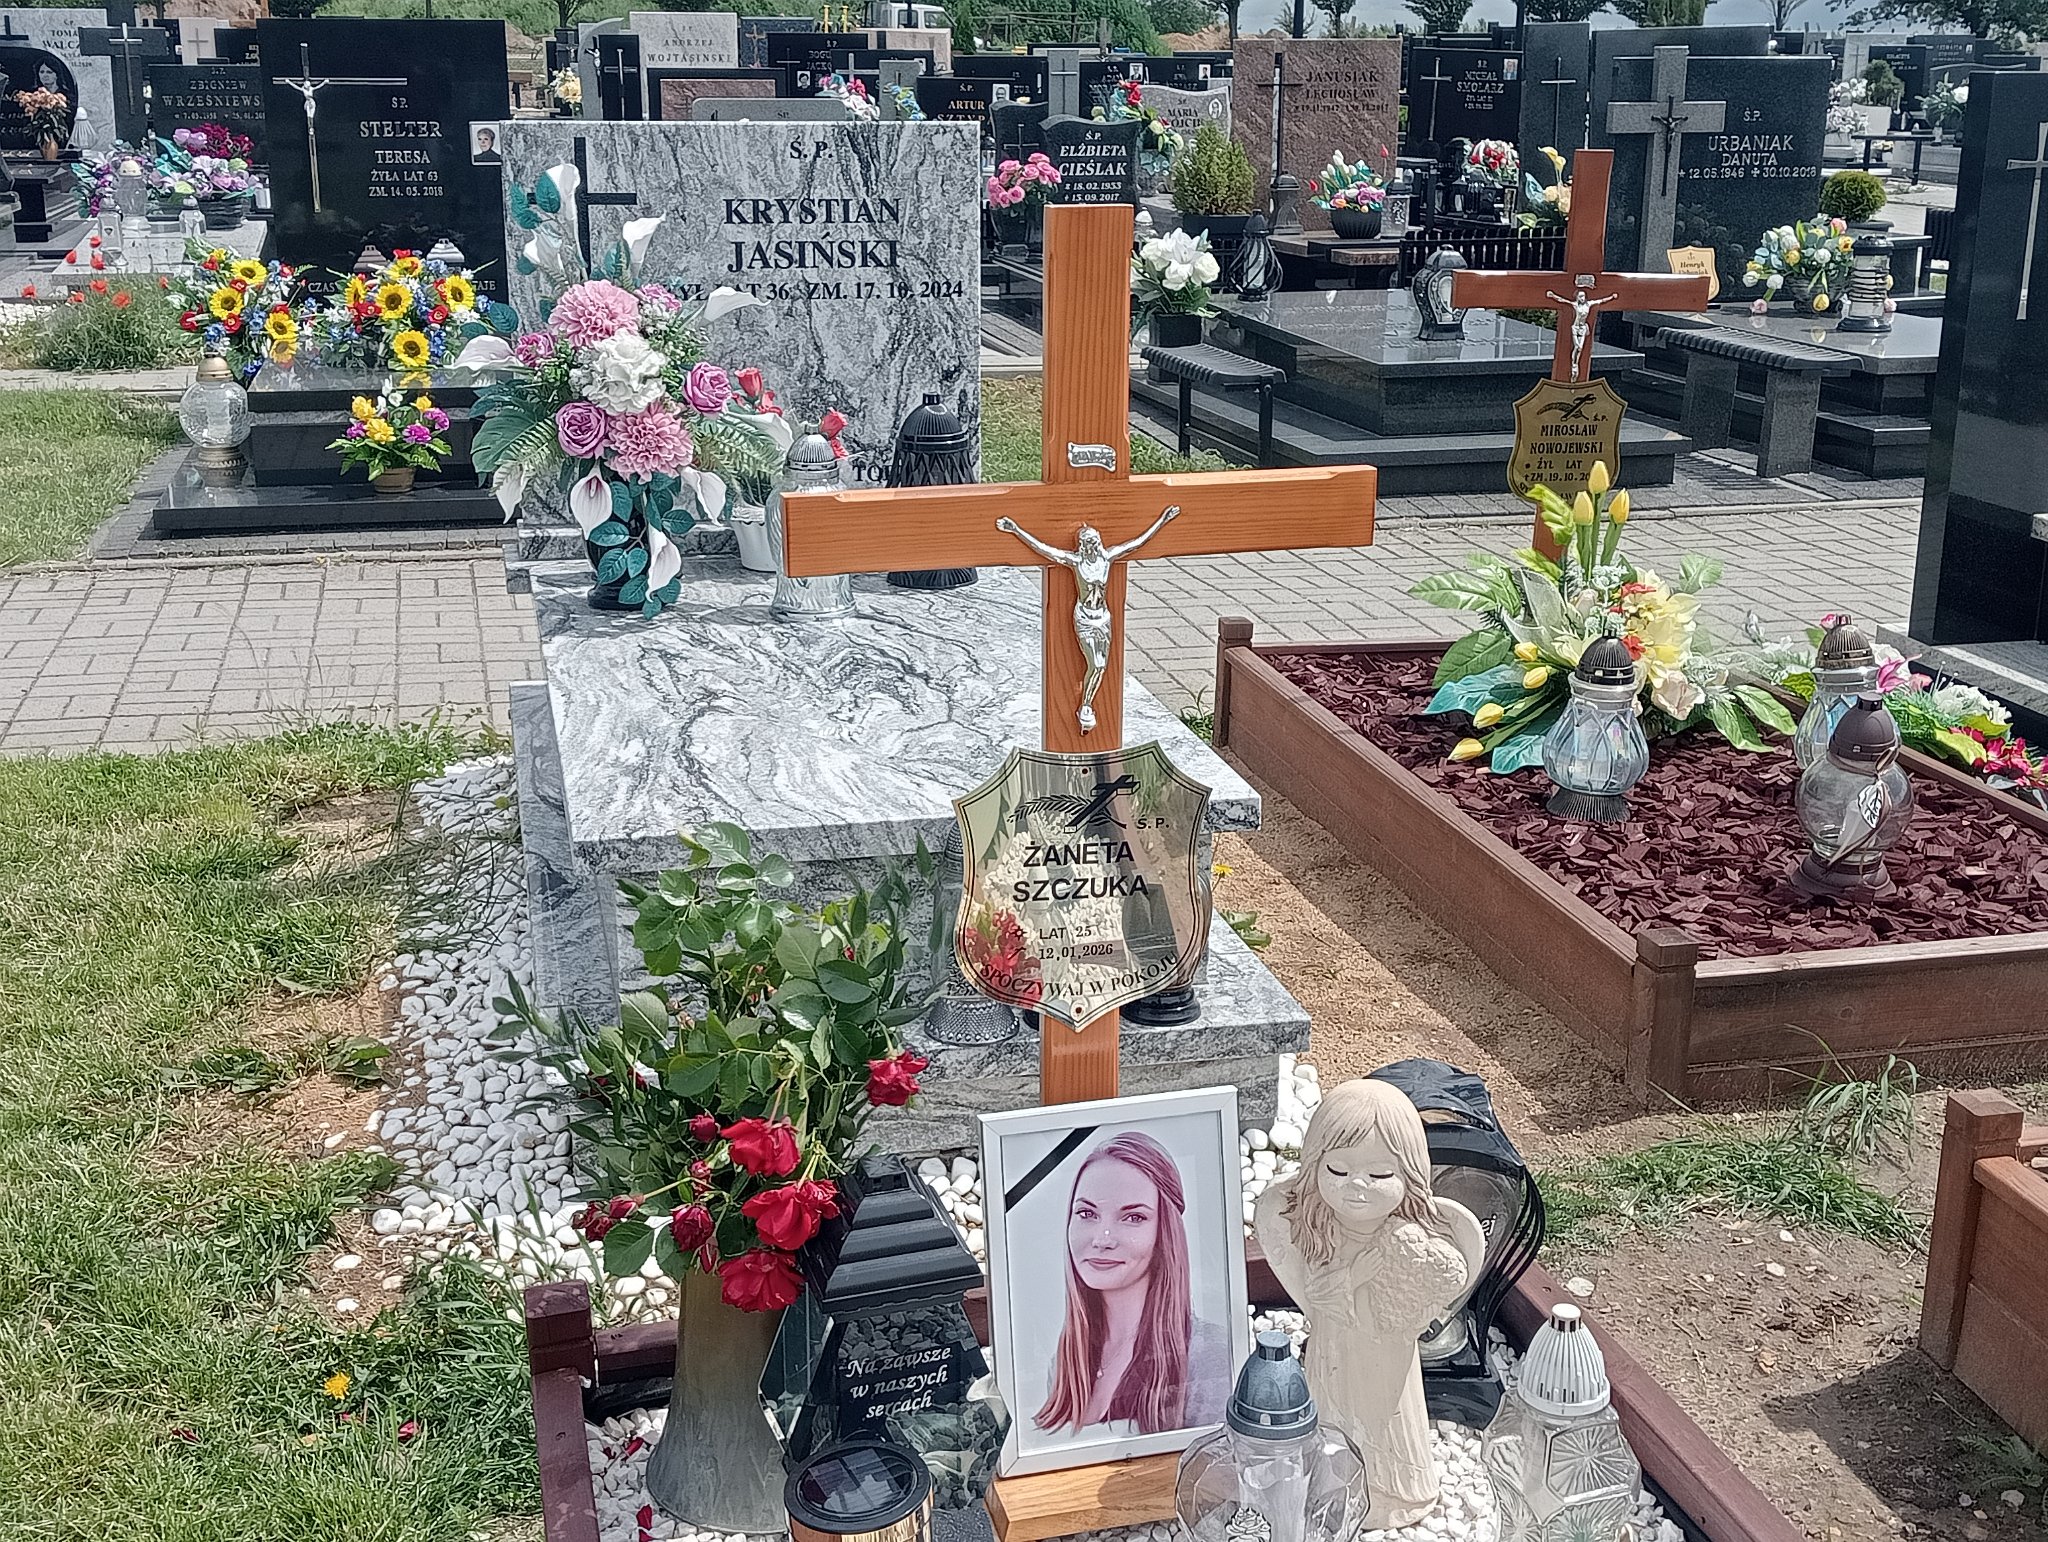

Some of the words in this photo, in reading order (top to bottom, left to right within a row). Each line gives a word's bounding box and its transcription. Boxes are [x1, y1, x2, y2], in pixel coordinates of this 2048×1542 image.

[189, 80, 247, 90] ZBIGNIEW
[1305, 70, 1379, 83] JANUSIAK
[947, 100, 985, 110] ARTUR
[360, 121, 443, 138] STELTER
[1060, 142, 1127, 157] ELŻBIETA
[1708, 134, 1794, 151] URBANIAK
[374, 149, 431, 164] TERESA
[1721, 153, 1778, 166] DANUTA
[370, 168, 400, 181] ŻYŁA
[403, 170, 425, 182] LAT
[427, 171, 438, 182] 63
[1058, 159, 1128, 176] CIEŚLAK
[722, 198, 902, 225] KRYSTIAN
[727, 231, 901, 272] JASIŃSKI
[919, 280, 964, 298] 2024
[1540, 424, 1598, 437] MIROSŁAW
[1529, 441, 1603, 454] NOWOJEWSKI
[1536, 457, 1554, 469] ŻYŁ
[1565, 460, 1583, 469] LAT
[1022, 840, 1135, 868] ŻANETA
[1012, 874, 1149, 902] SZCZUKA
[1039, 927, 1066, 940] LAT
[1075, 925, 1092, 938] 25
[980, 963, 1085, 997] SPOCZYWAJ
[1091, 980, 1107, 995] W
[1111, 952, 1180, 991] POKOJU
[845, 1358, 879, 1378] Na
[880, 1347, 951, 1371] zawsze
[850, 1383, 869, 1399] w
[874, 1364, 948, 1395] naszych
[866, 1389, 933, 1419] sercach
